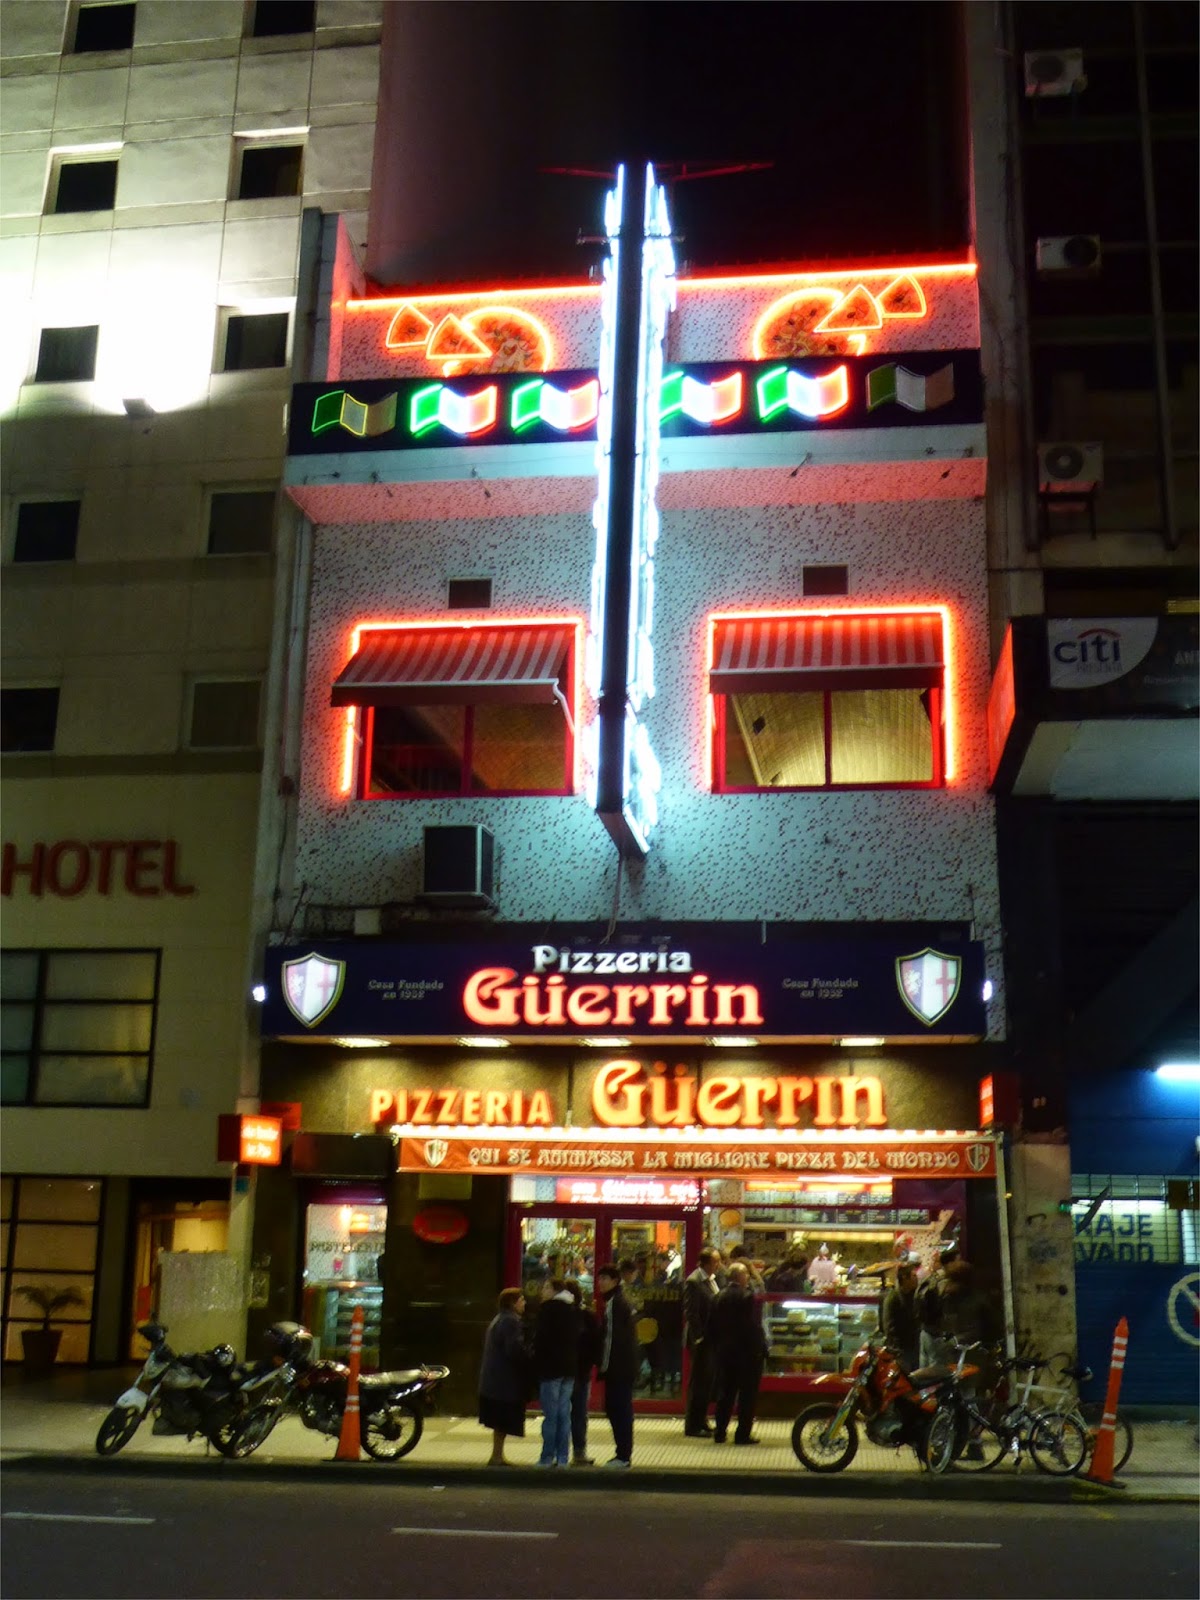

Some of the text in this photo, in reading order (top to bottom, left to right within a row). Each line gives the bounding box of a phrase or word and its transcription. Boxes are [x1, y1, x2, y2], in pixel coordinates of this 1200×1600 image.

[1054, 635, 1121, 663] citi
[1, 839, 197, 897] HOTEL
[532, 945, 693, 973] Pizzeria
[463, 967, 764, 1026] Güerrin
[370, 1059, 888, 1127] PIZZERIA Güerrin
[468, 1147, 500, 1167] QUI
[507, 1148, 531, 1167] SE
[643, 1150, 669, 1169] LA
[674, 1151, 771, 1170] MIGLIORE
[775, 1151, 838, 1170] PIZZA
[842, 1151, 881, 1169] DEL
[885, 1151, 960, 1169] MONDO
